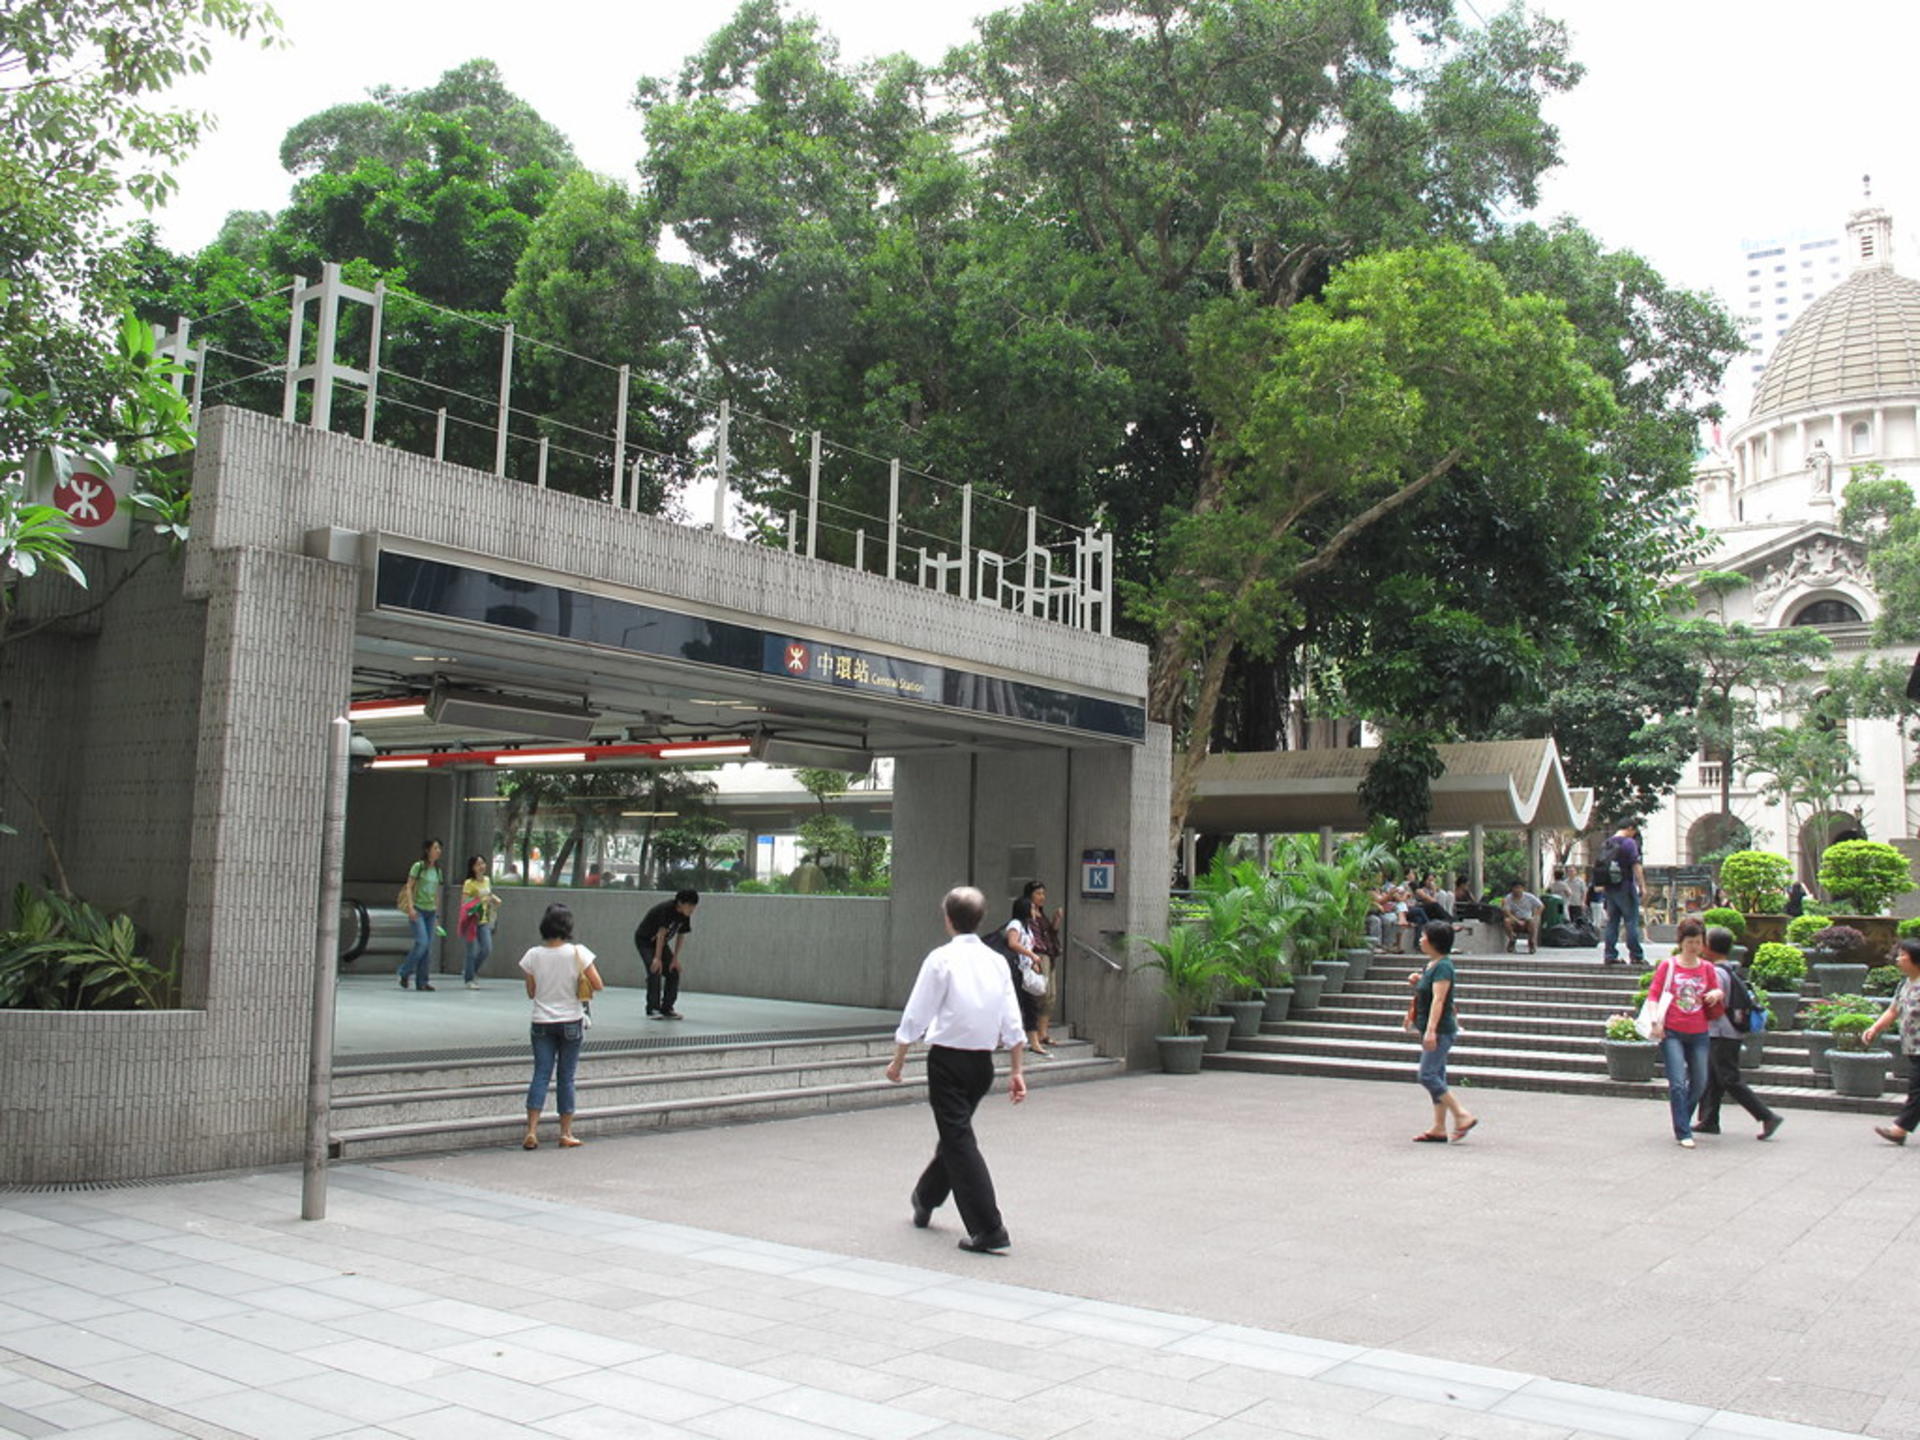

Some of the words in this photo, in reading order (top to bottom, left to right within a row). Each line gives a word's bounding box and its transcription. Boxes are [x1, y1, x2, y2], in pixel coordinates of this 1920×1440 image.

[816, 651, 869, 683] 中環站
[871, 672, 897, 688] Central
[899, 678, 925, 693] Station
[1094, 870, 1104, 886] K
